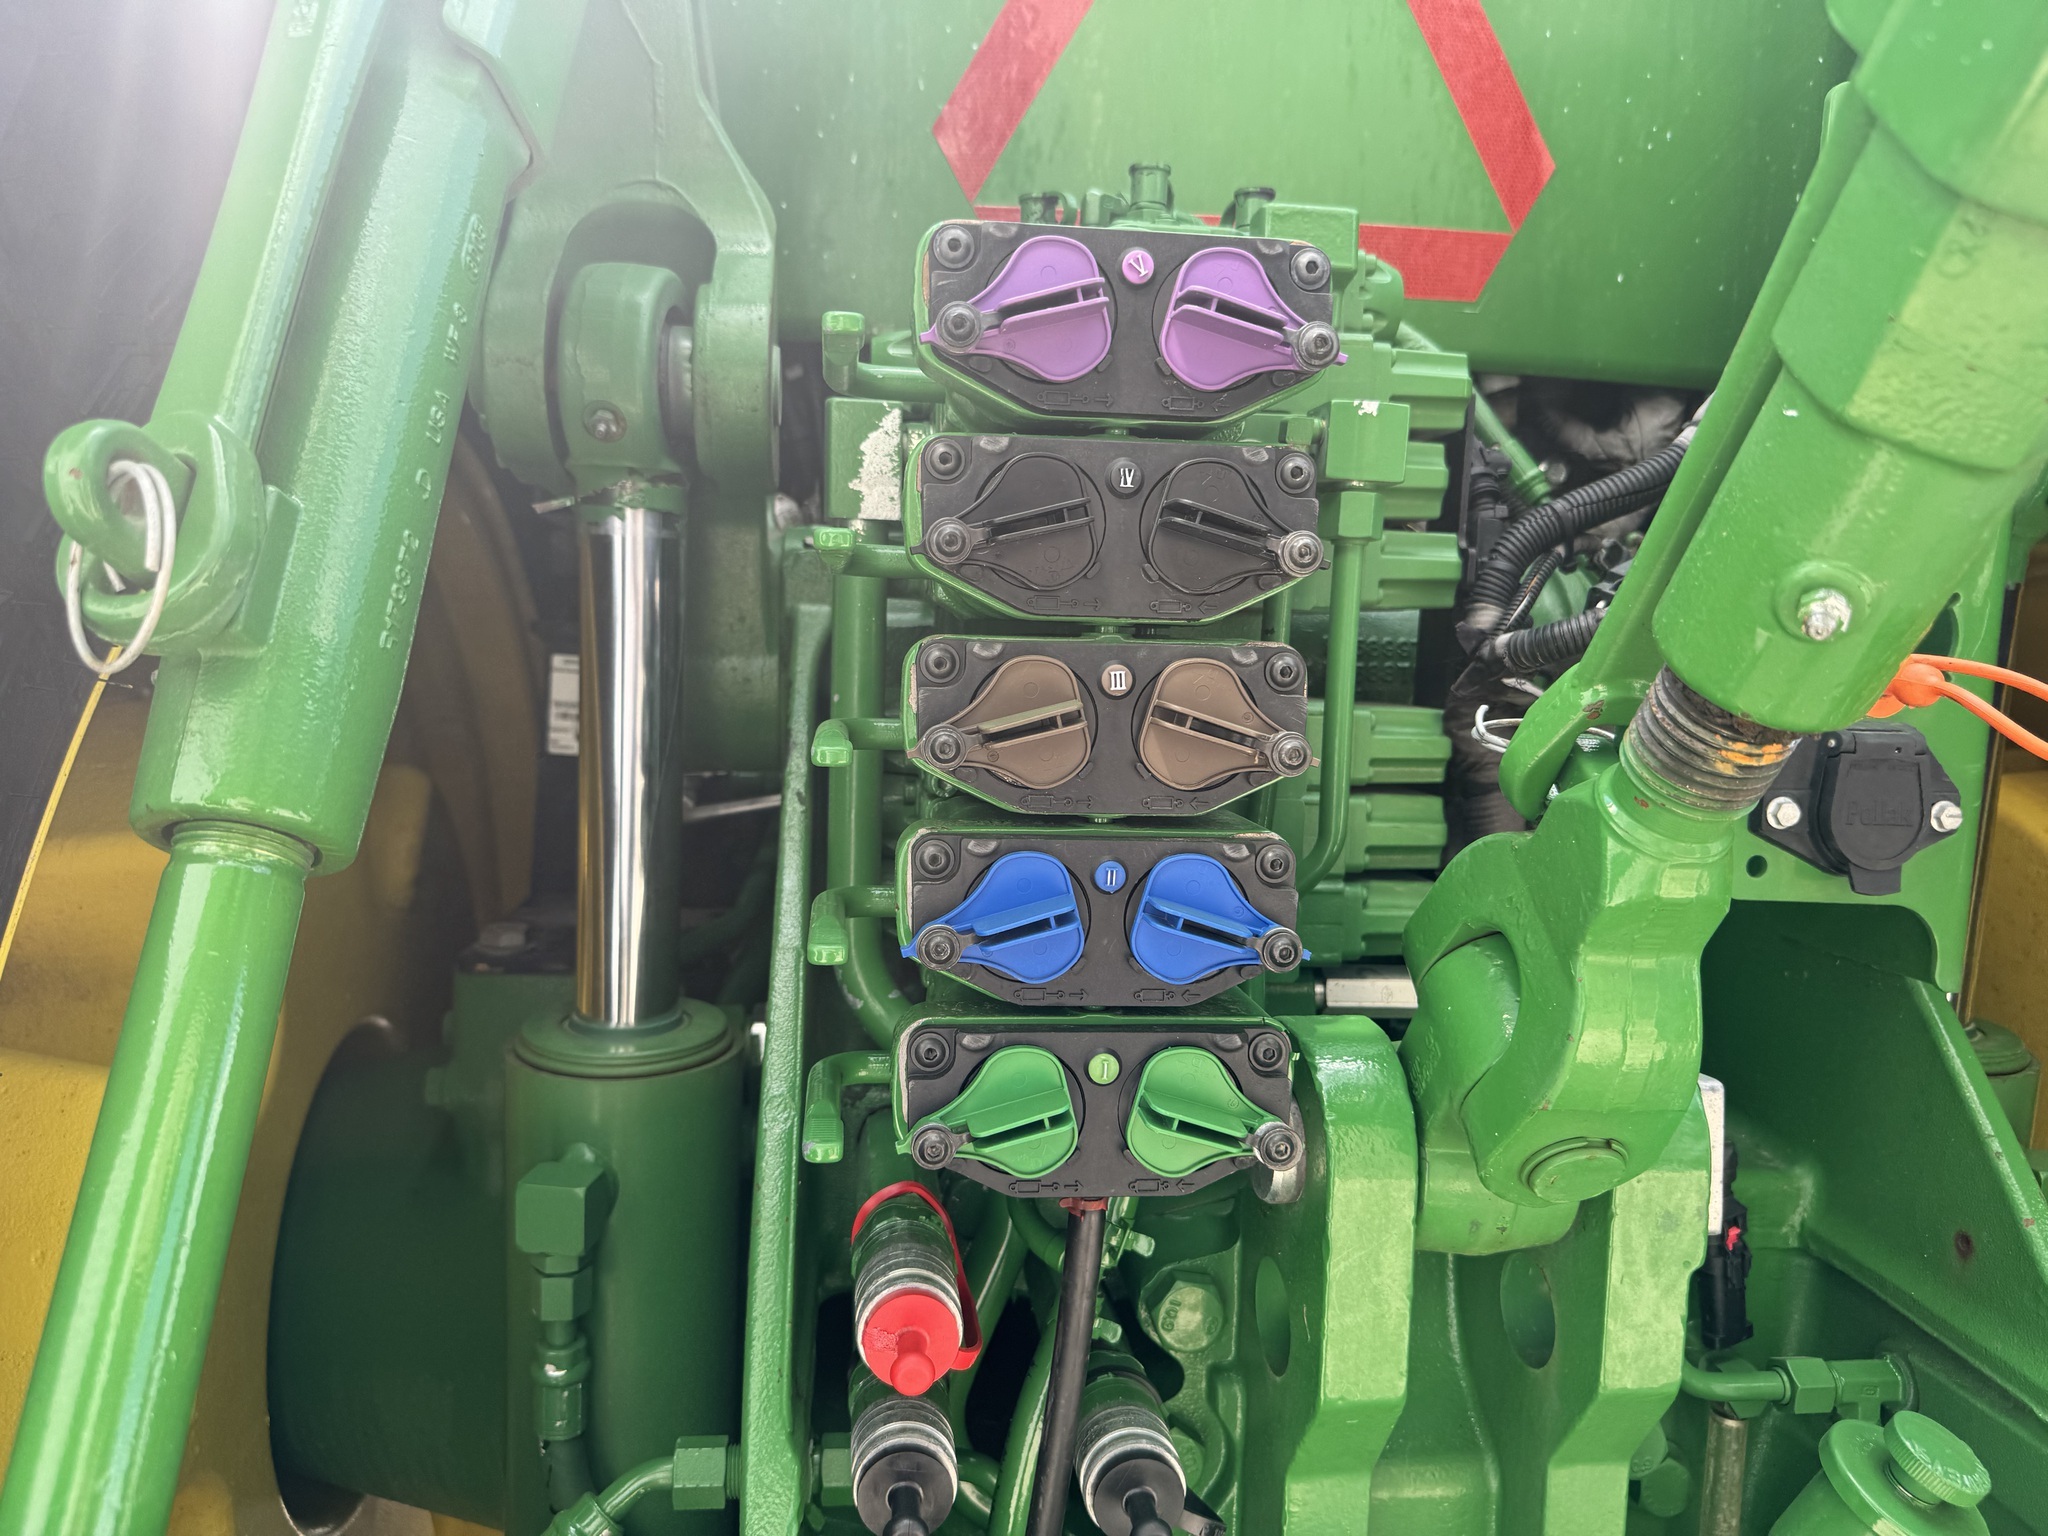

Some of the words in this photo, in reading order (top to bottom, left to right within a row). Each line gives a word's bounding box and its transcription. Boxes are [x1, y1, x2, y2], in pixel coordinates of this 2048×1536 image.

[1128, 254, 1149, 277] V
[426, 390, 450, 443] USA
[1119, 467, 1135, 488] IV
[1109, 670, 1127, 691] III
[1105, 867, 1119, 887] II
[1101, 1060, 1110, 1081] I
